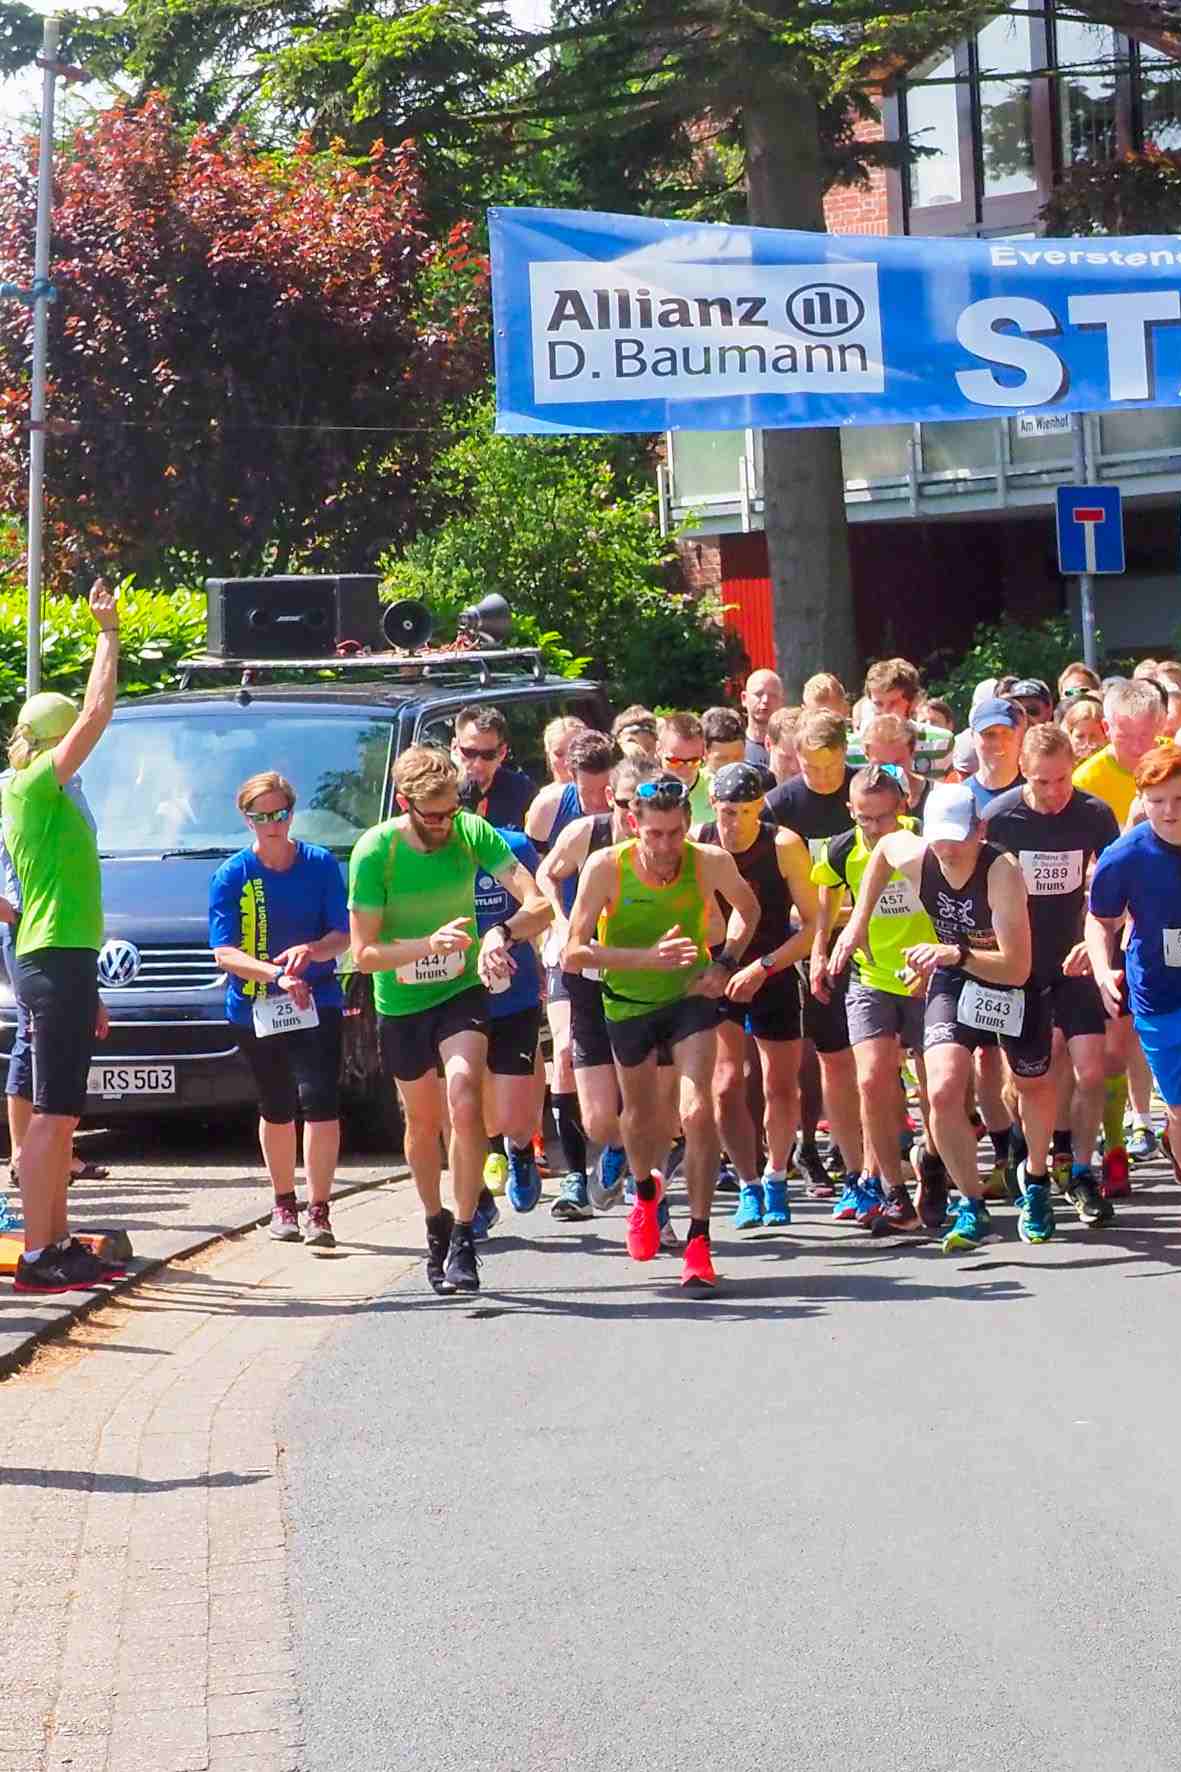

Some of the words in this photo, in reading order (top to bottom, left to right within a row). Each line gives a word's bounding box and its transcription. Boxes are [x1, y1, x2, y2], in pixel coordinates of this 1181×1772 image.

[546, 289, 769, 333] Allianz
[549, 340, 599, 381] D.
[615, 337, 869, 378] Baumann
[1034, 867, 1068, 880] 2389
[1036, 879, 1065, 891] bruns
[276, 1004, 293, 1016] 25
[975, 997, 1010, 1016] 2643
[975, 1010, 1006, 1028] bruns
[103, 1070, 129, 1090] RS
[134, 1070, 172, 1090] 503
